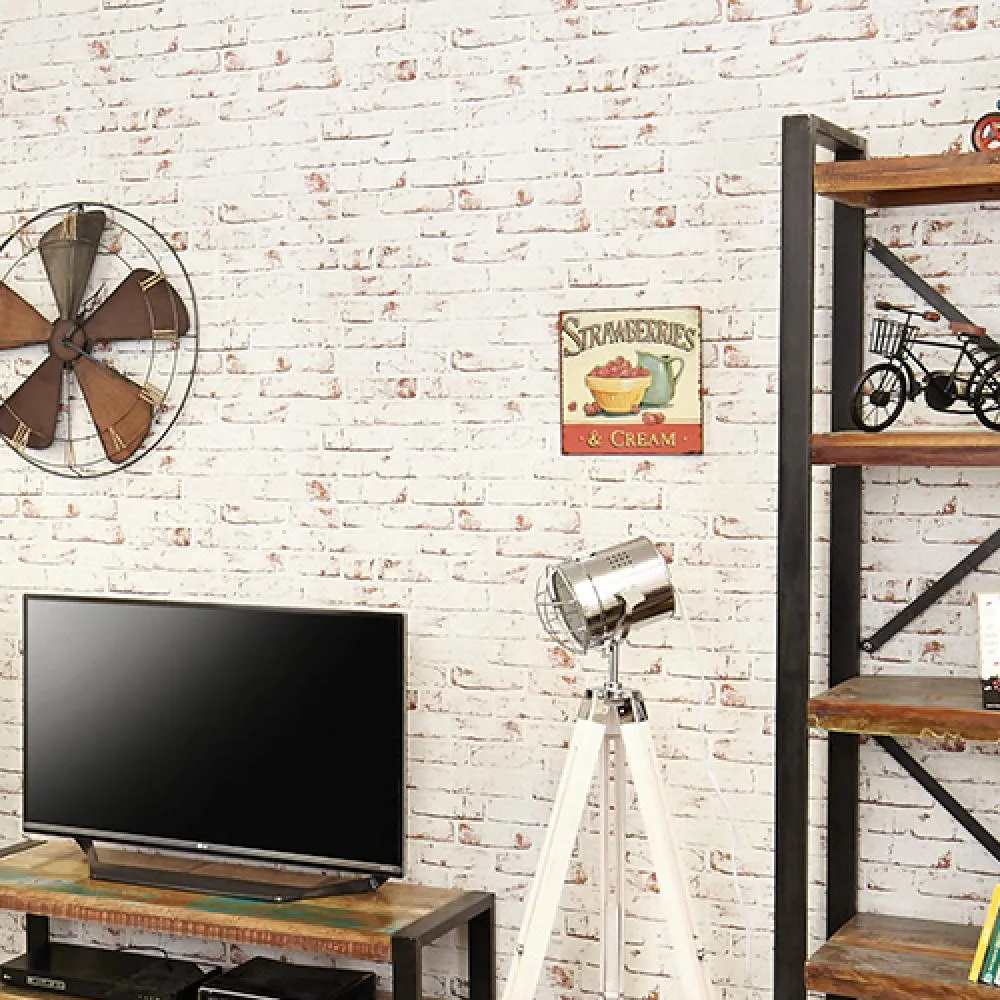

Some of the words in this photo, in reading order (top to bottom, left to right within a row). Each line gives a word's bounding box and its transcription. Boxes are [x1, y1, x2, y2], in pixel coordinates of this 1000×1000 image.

[563, 316, 698, 358] STRAWBERRIES
[586, 430, 602, 448] &
[609, 429, 677, 449] CREAM
